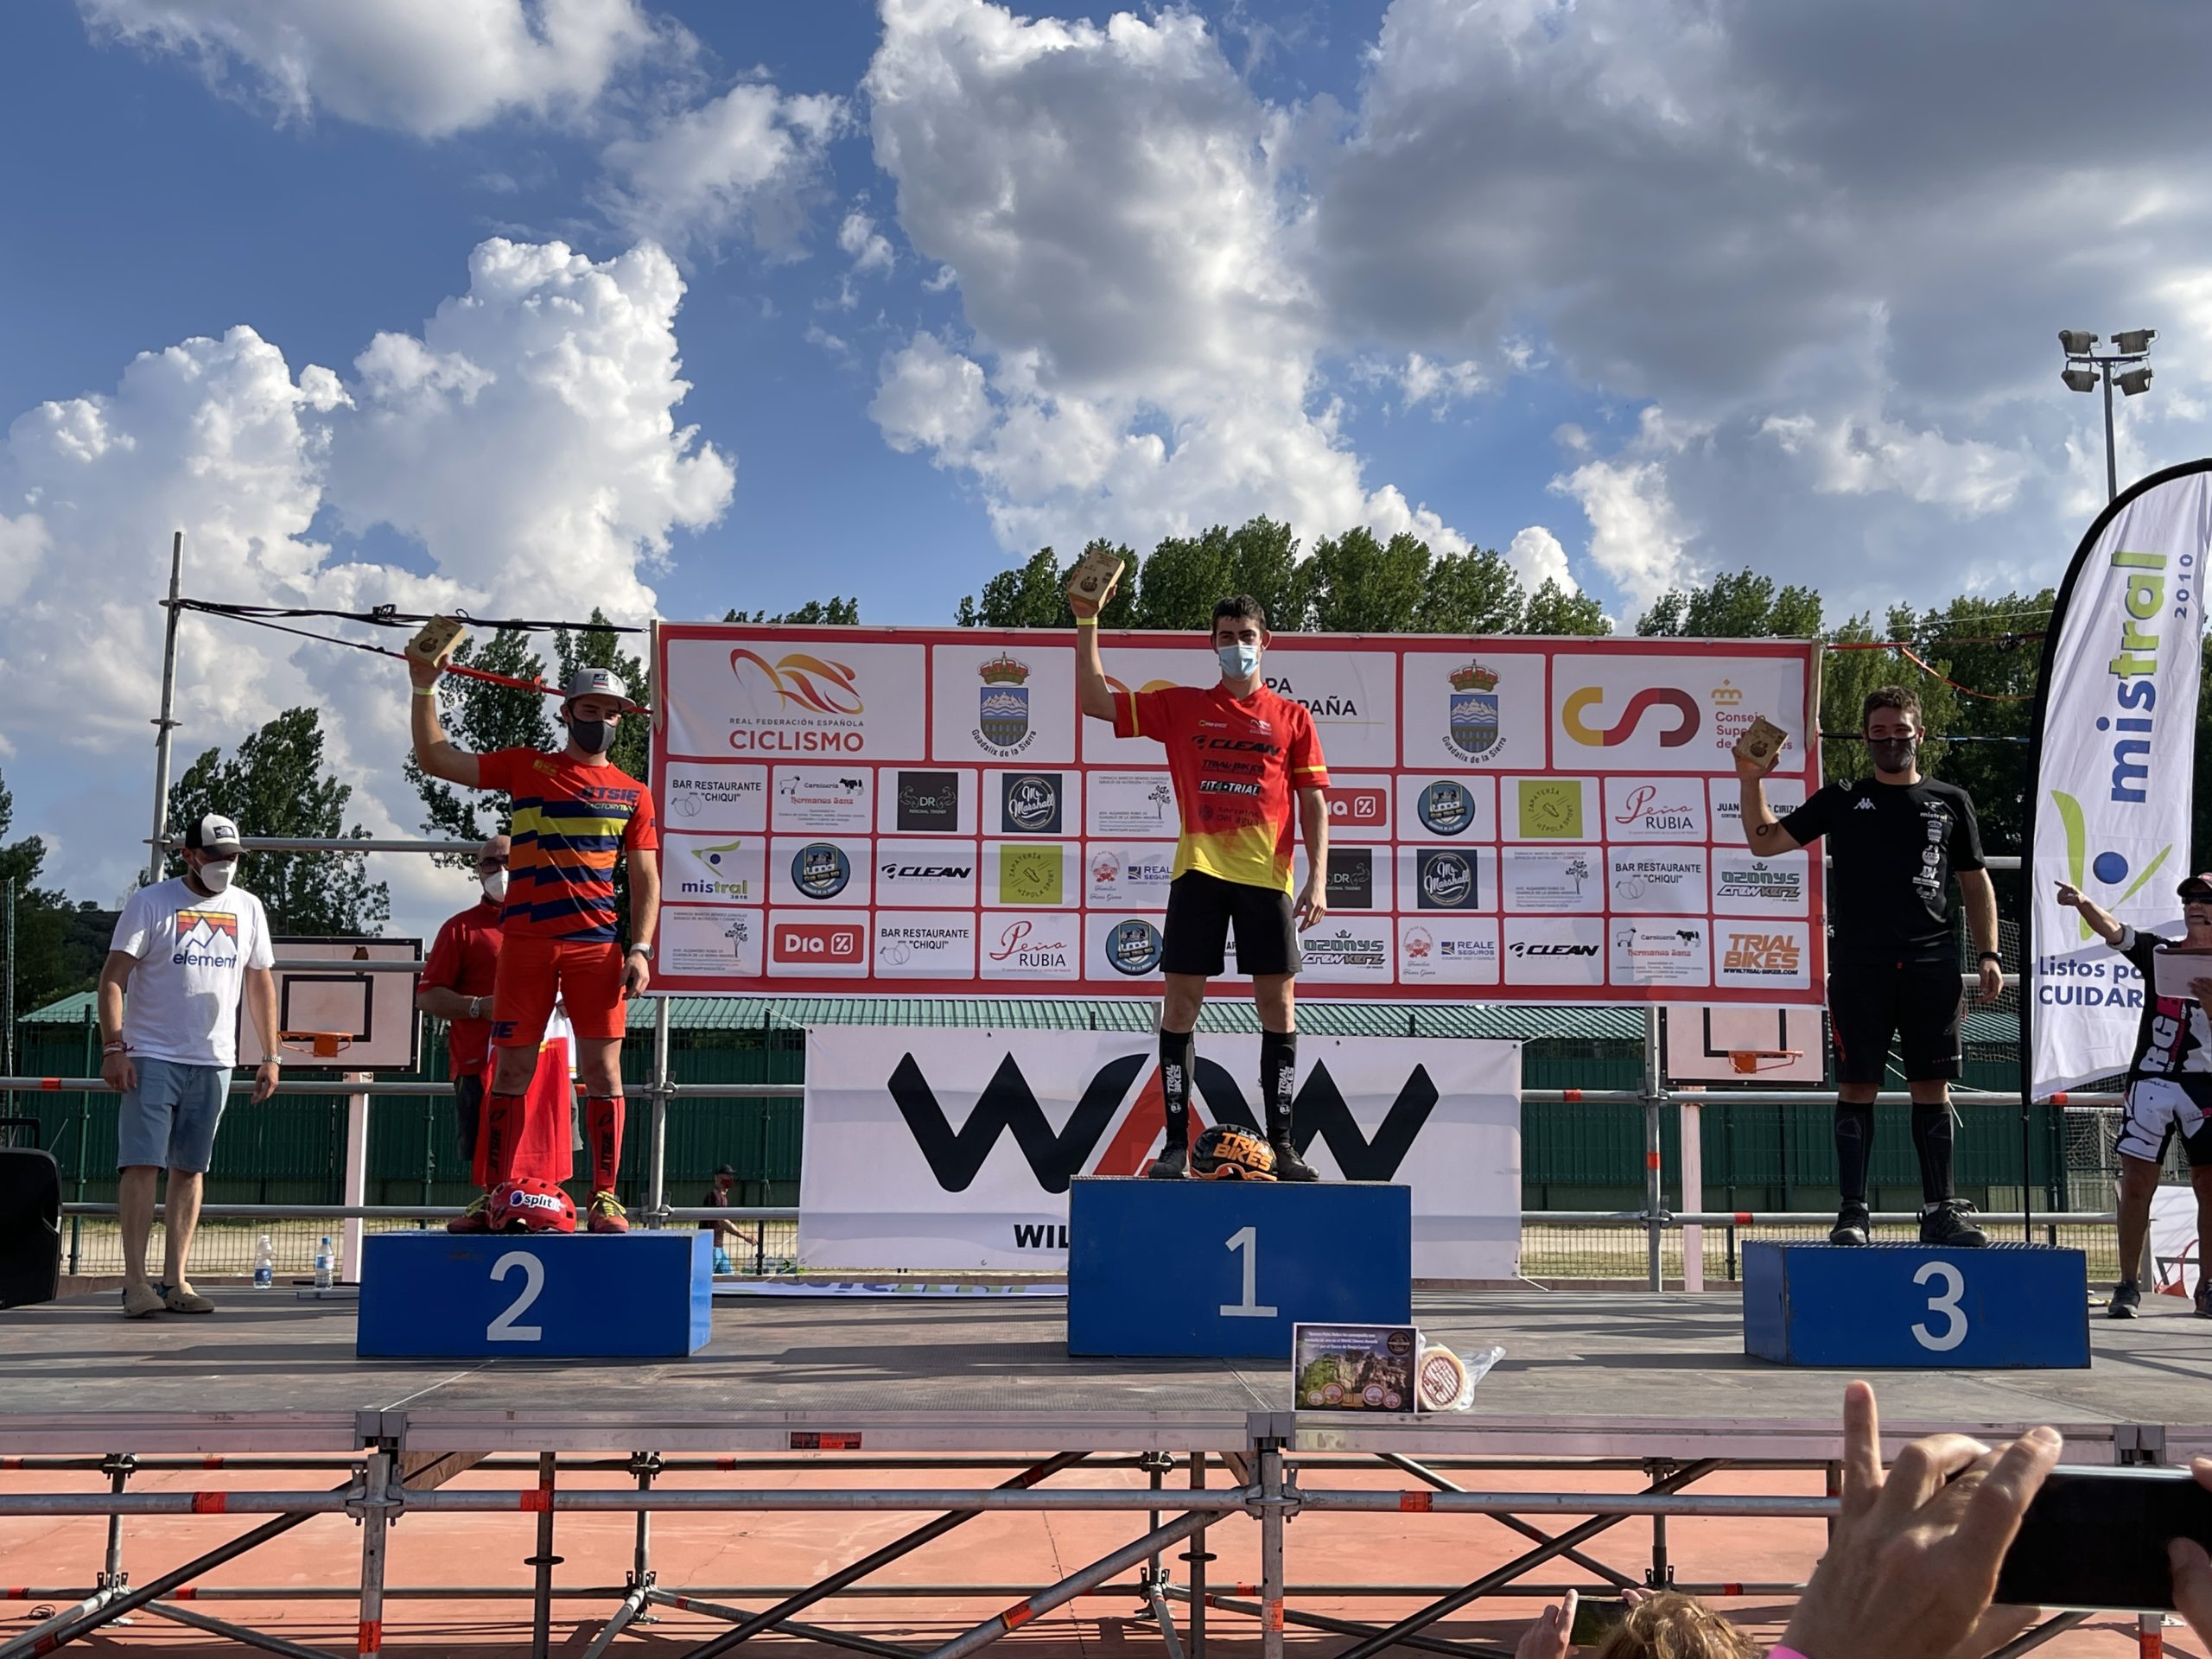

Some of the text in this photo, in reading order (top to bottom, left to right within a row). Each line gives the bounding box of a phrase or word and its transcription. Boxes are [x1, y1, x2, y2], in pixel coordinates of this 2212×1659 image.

[2174, 554, 2193, 620] 2010
[1265, 677, 1293, 694] PA
[2097, 552, 2167, 803] mistral
[756, 717, 814, 726] FEDERACIÓN
[817, 718, 864, 727] ESPAÑOLA
[729, 730, 864, 752] CICLISMO
[972, 729, 1037, 758] Guadalix de la Sierra
[1208, 739, 1281, 756] CLEAN
[1716, 738, 1732, 748] de
[1442, 736, 1468, 763] Guadalix
[1471, 755, 1480, 764] de
[1490, 737, 1507, 758] Sierra
[672, 780, 762, 791] BAR RESTAURANTE
[701, 792, 741, 803] "CHIQUI"
[920, 797, 935, 806] DR
[1008, 793, 1054, 817] Marshall
[1717, 803, 1739, 811] JUAN
[1646, 817, 1694, 830] RUBIA
[898, 867, 972, 879] CLEAN
[1615, 862, 1701, 873] BAR RESTAURANTE
[682, 879, 748, 894] mistral
[1334, 874, 1349, 883] DR
[1424, 868, 1469, 893] Marshall
[1643, 874, 1683, 884] "CHIQUI"
[881, 929, 969, 938] BAR RESTAURANTE
[909, 940, 949, 950] "CHIQUI"
[1526, 944, 1599, 957] CLEAN
[1728, 934, 1800, 952] TRIAL
[173, 950, 237, 969] element
[1019, 953, 1066, 967] RUBIA
[1724, 951, 1800, 969] BIKES
[2039, 956, 2105, 977] Listos
[1166, 1065, 1176, 1094] TRIAL
[1278, 1065, 1288, 1095] TRIAL
[1212, 1143, 1273, 1171] BIKES
[1220, 1227, 1278, 1318] 1
[486, 1251, 545, 1341] 2
[1910, 1261, 1968, 1351] 3
